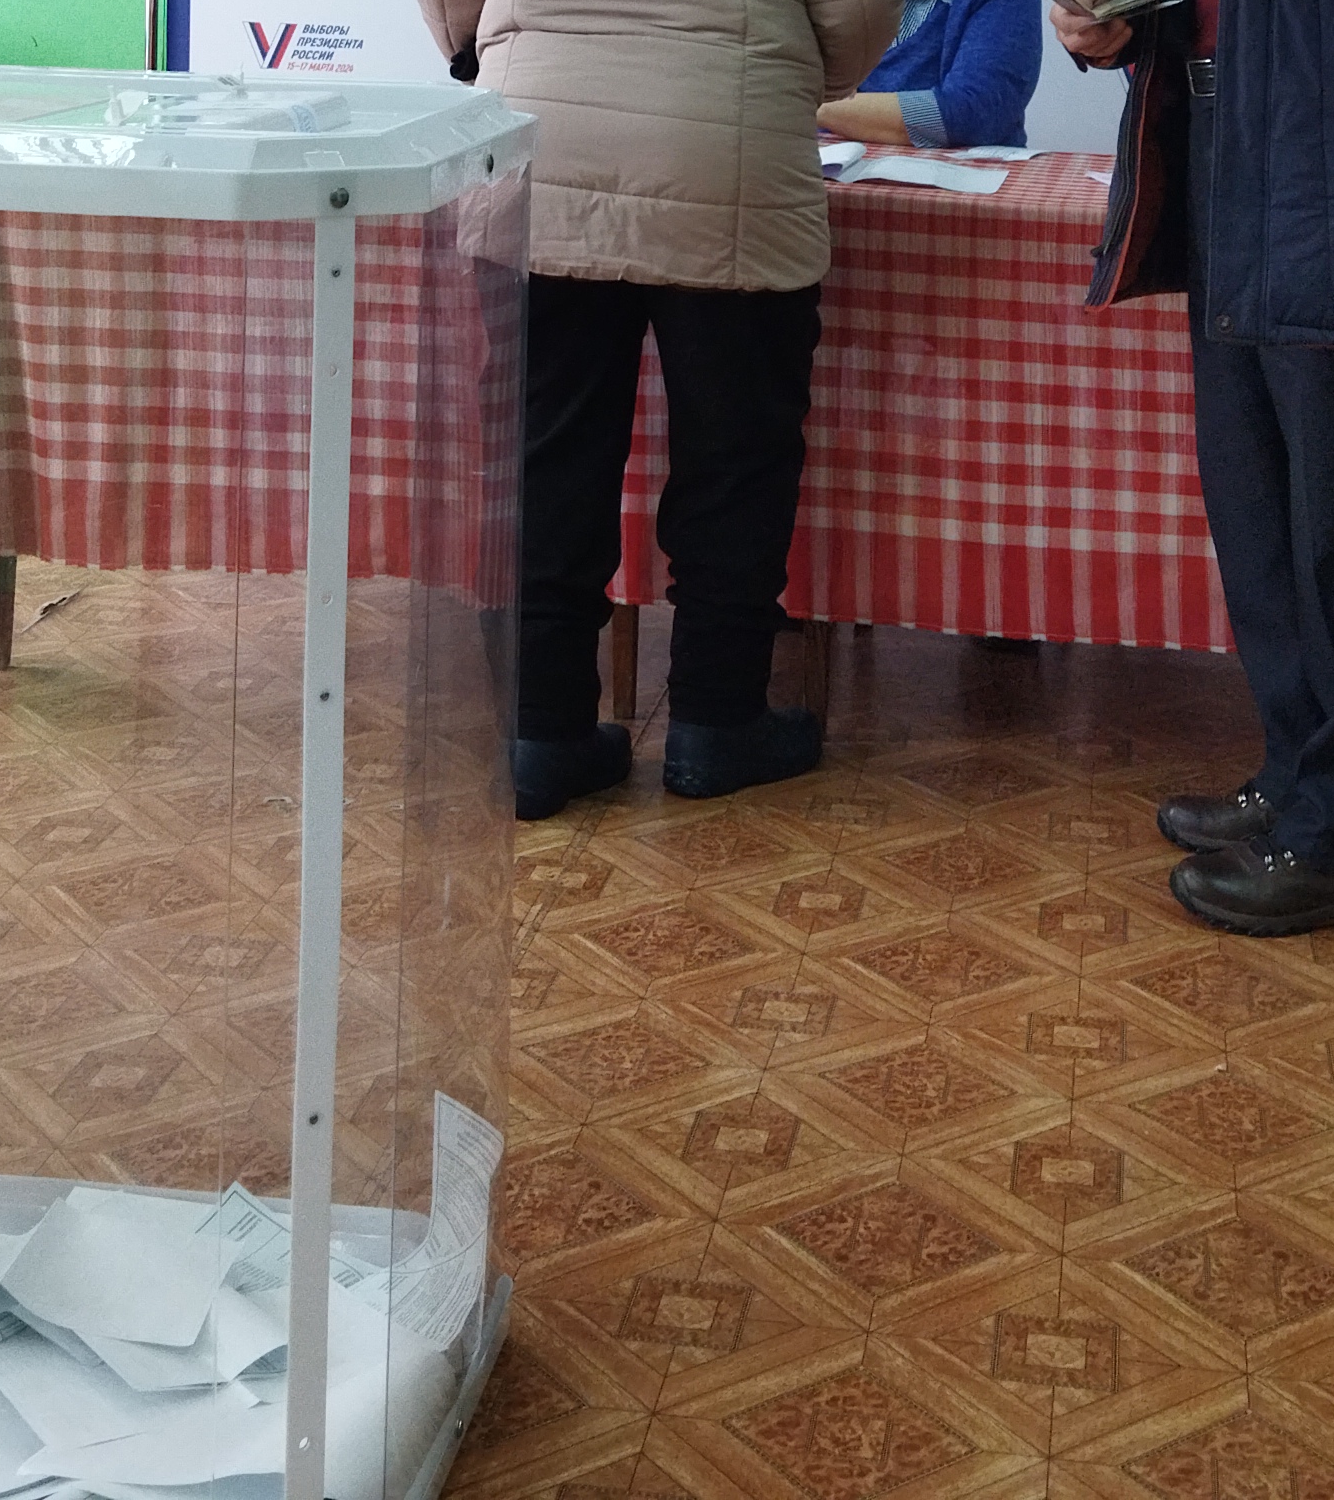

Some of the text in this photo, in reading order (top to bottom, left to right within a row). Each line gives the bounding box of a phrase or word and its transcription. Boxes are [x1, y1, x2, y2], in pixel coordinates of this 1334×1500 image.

[302, 24, 350, 36] ВЫБОРЫ
[296, 37, 364, 49] ПРЕЗИДЕНТА
[291, 49, 334, 61] РОССИИ
[308, 62, 335, 72] МАРТА
[335, 64, 354, 73] 2024
